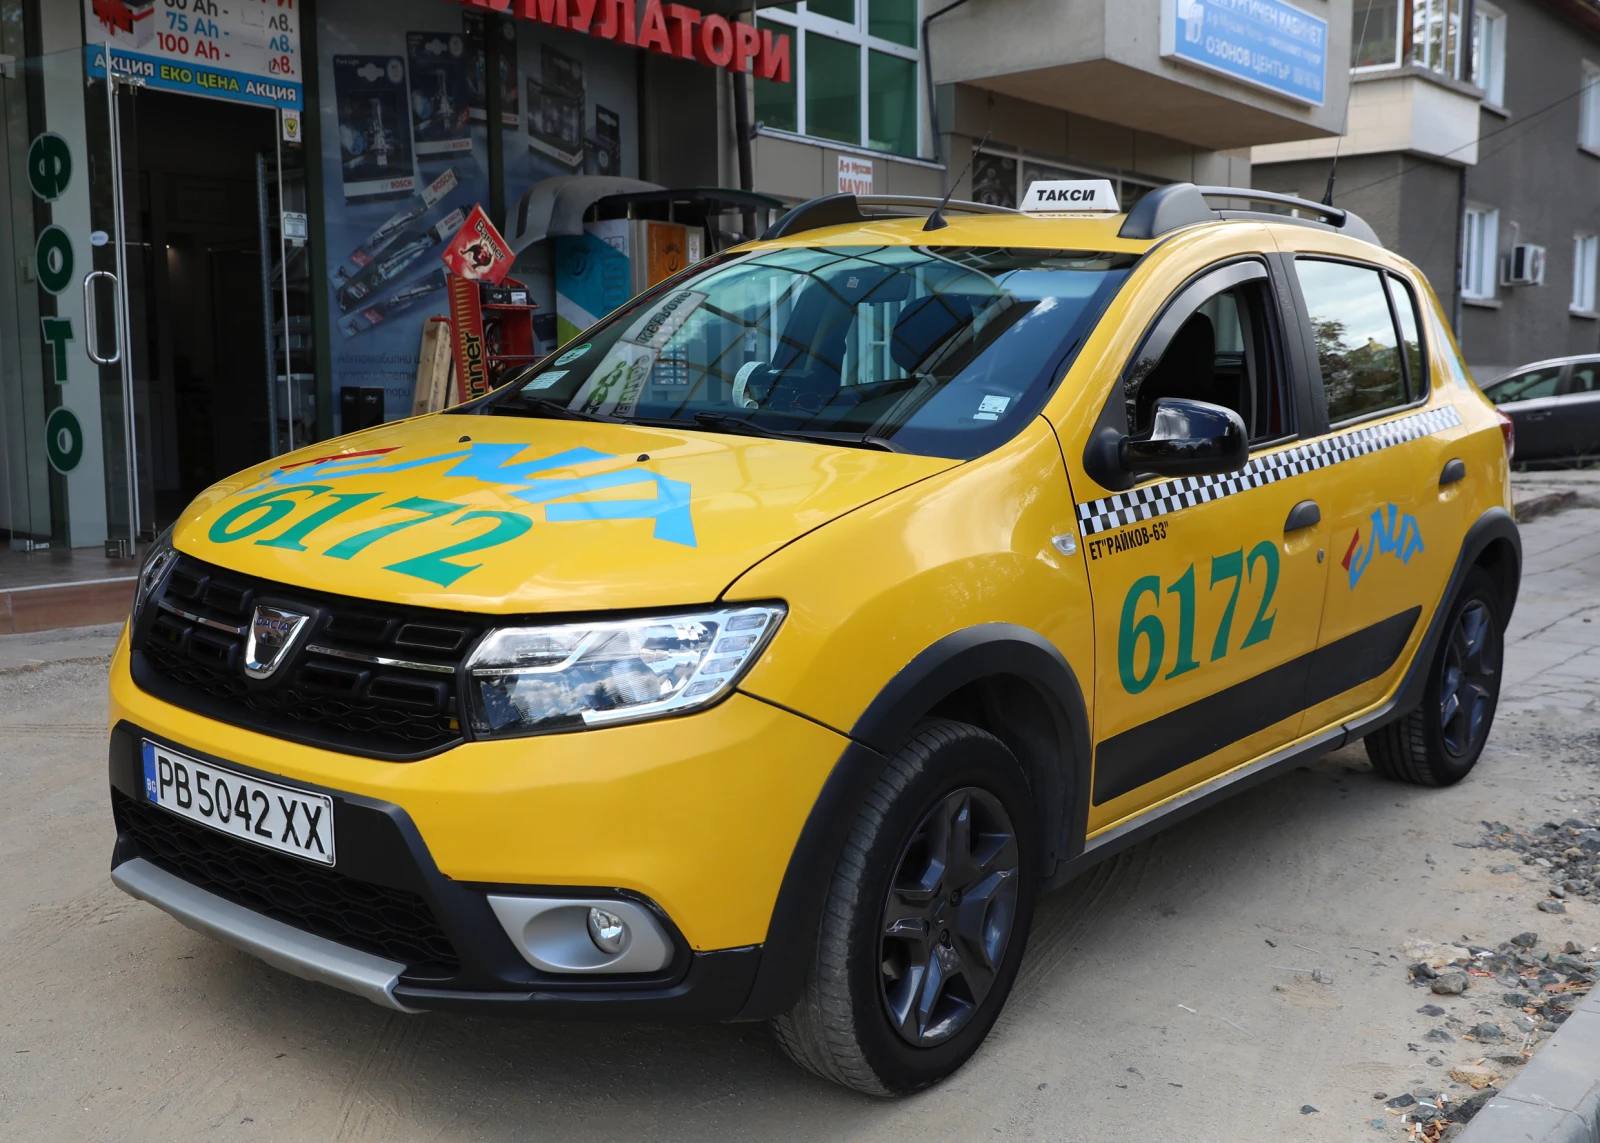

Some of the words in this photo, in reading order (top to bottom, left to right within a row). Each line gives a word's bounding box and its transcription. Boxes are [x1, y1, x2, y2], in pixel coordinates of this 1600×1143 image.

[193, 0, 218, 17] Ah
[268, 13, 293, 33] лв.
[157, 32, 189, 55] 100
[195, 39, 220, 61] Ah
[166, 11, 189, 33] 75
[194, 17, 219, 39] Ah
[269, 34, 294, 54] лв.
[468, 0, 791, 83] УЛАТОРИ
[1206, 36, 1250, 67] ОЗОНОВ
[94, 53, 154, 77] АКЦИЯ
[160, 65, 192, 84] ЕКО
[196, 72, 240, 92] ЦЕНА
[245, 81, 296, 102] АКЦИЯ
[452, 140, 471, 149] BOSCH
[390, 179, 413, 190] BOSCH
[432, 171, 454, 193] BOSCH
[1036, 189, 1096, 202] ТАКСИ
[444, 211, 461, 226] BOSCH
[475, 219, 506, 261] Banner
[27, 131, 84, 475] ФОТО
[338, 352, 412, 365] Автомобилни
[208, 485, 533, 588] 6172
[255, 616, 290, 632] DACIA
[1117, 540, 1281, 695] 6172
[146, 777, 157, 794] BG
